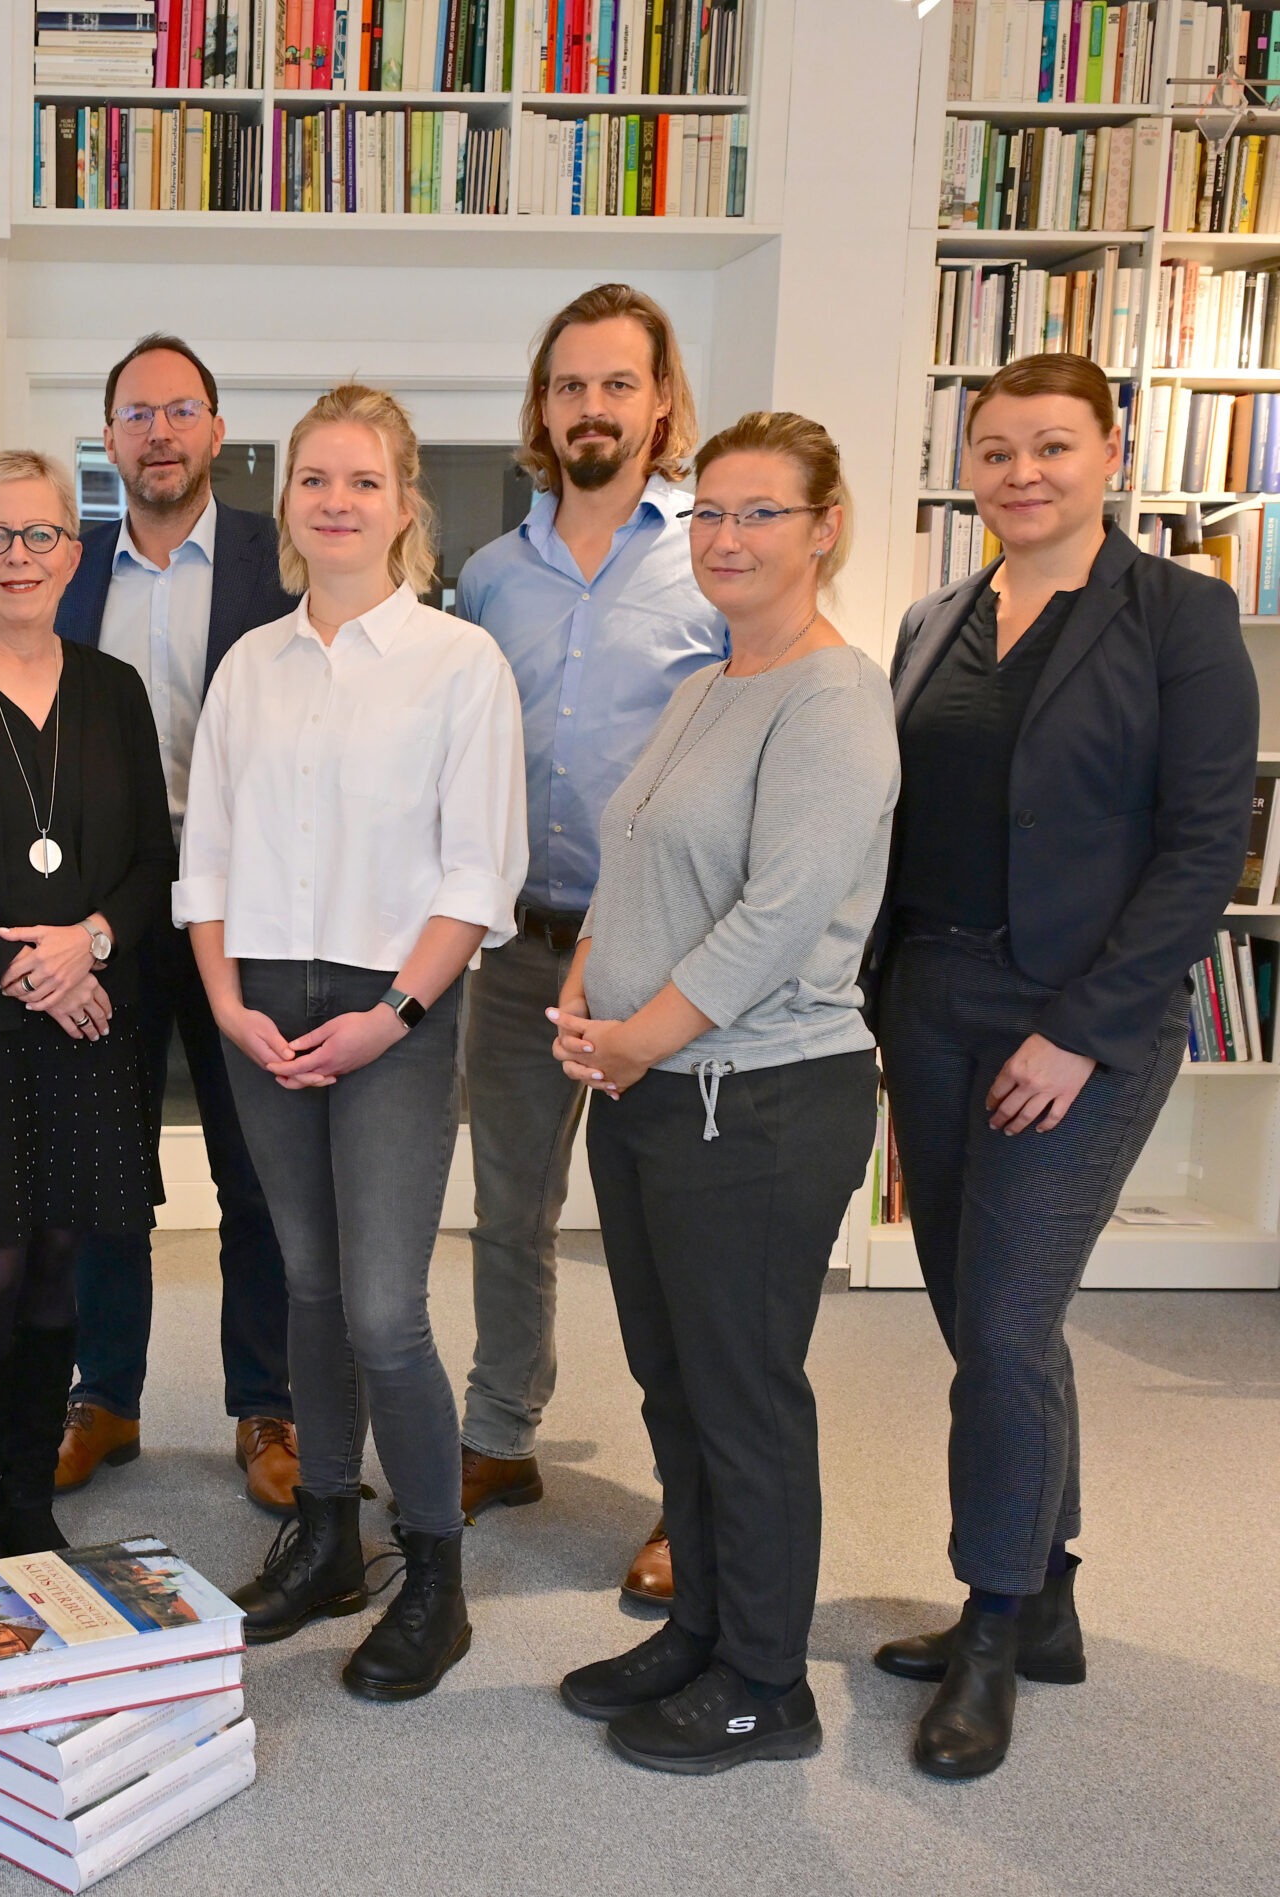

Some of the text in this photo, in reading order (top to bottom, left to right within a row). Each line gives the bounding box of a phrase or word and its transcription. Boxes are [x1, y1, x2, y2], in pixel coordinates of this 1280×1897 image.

[1263, 516, 1275, 592] ROSTOCK-LEXIKON
[23, 1563, 99, 1629] KLOSTERBUCH
[726, 1715, 757, 1734] S
